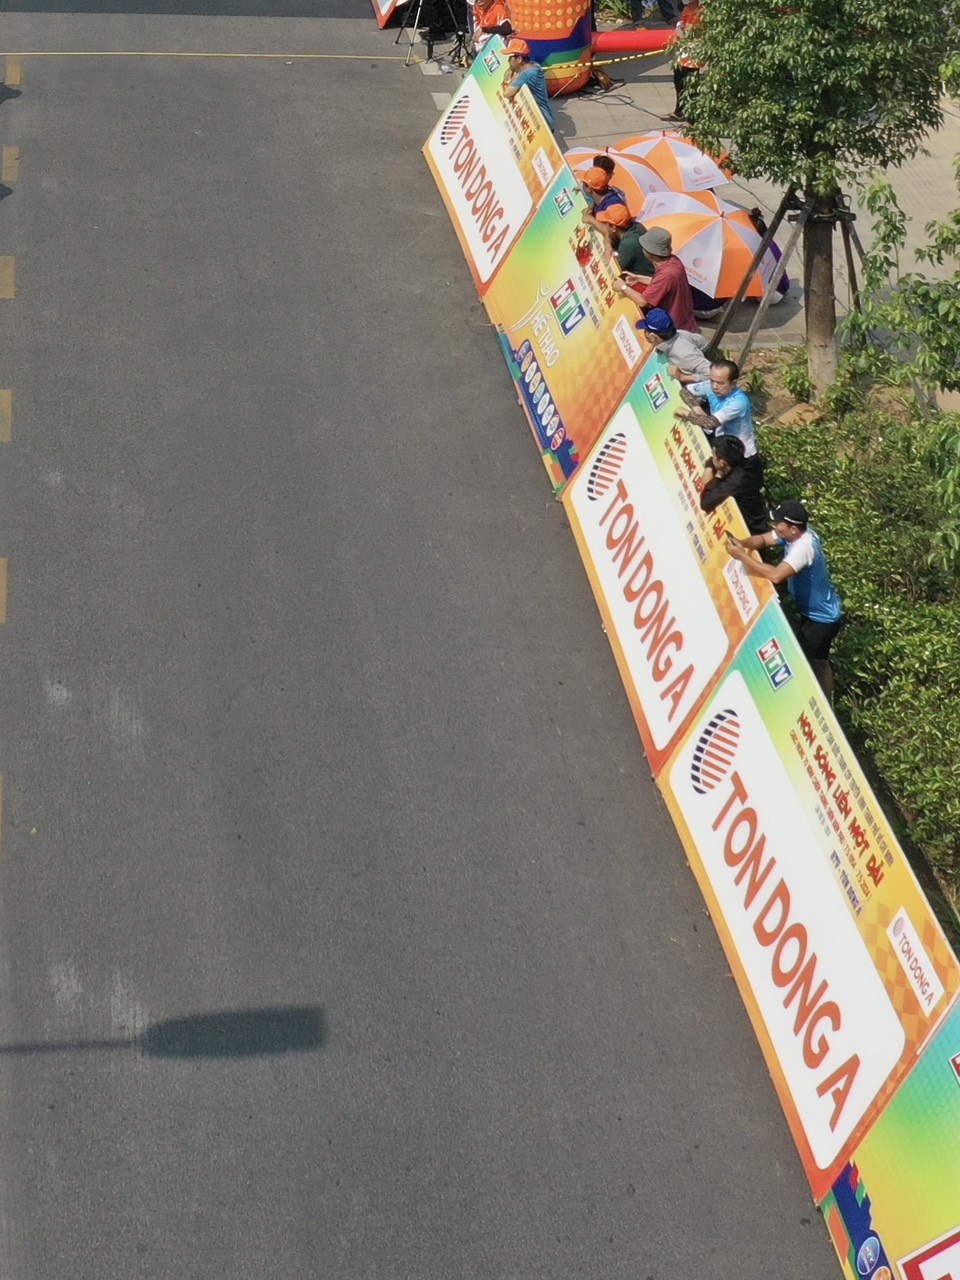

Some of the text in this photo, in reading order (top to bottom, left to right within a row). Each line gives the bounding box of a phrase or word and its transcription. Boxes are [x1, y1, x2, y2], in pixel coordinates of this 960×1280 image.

[449, 124, 510, 264] TON DONG A
[554, 188, 574, 216] HTV
[551, 278, 586, 333] HTV
[644, 373, 669, 410] HTV
[670, 425, 685, 449] NON
[681, 445, 697, 477] SÔNG
[599, 478, 695, 722] TON DONG A
[732, 569, 752, 618] TON DONG A
[758, 638, 792, 689] HTV
[796, 710, 817, 748] NON
[813, 744, 837, 791] SÔNG
[833, 783, 852, 822] LIỀN
[848, 817, 870, 858] MỘT
[866, 853, 885, 887] DẢI
[830, 850, 841, 870] HTV
[840, 868, 851, 892] TÔN
[711, 770, 861, 1134] TON DONG A
[899, 932, 935, 1006] TON DONG A
